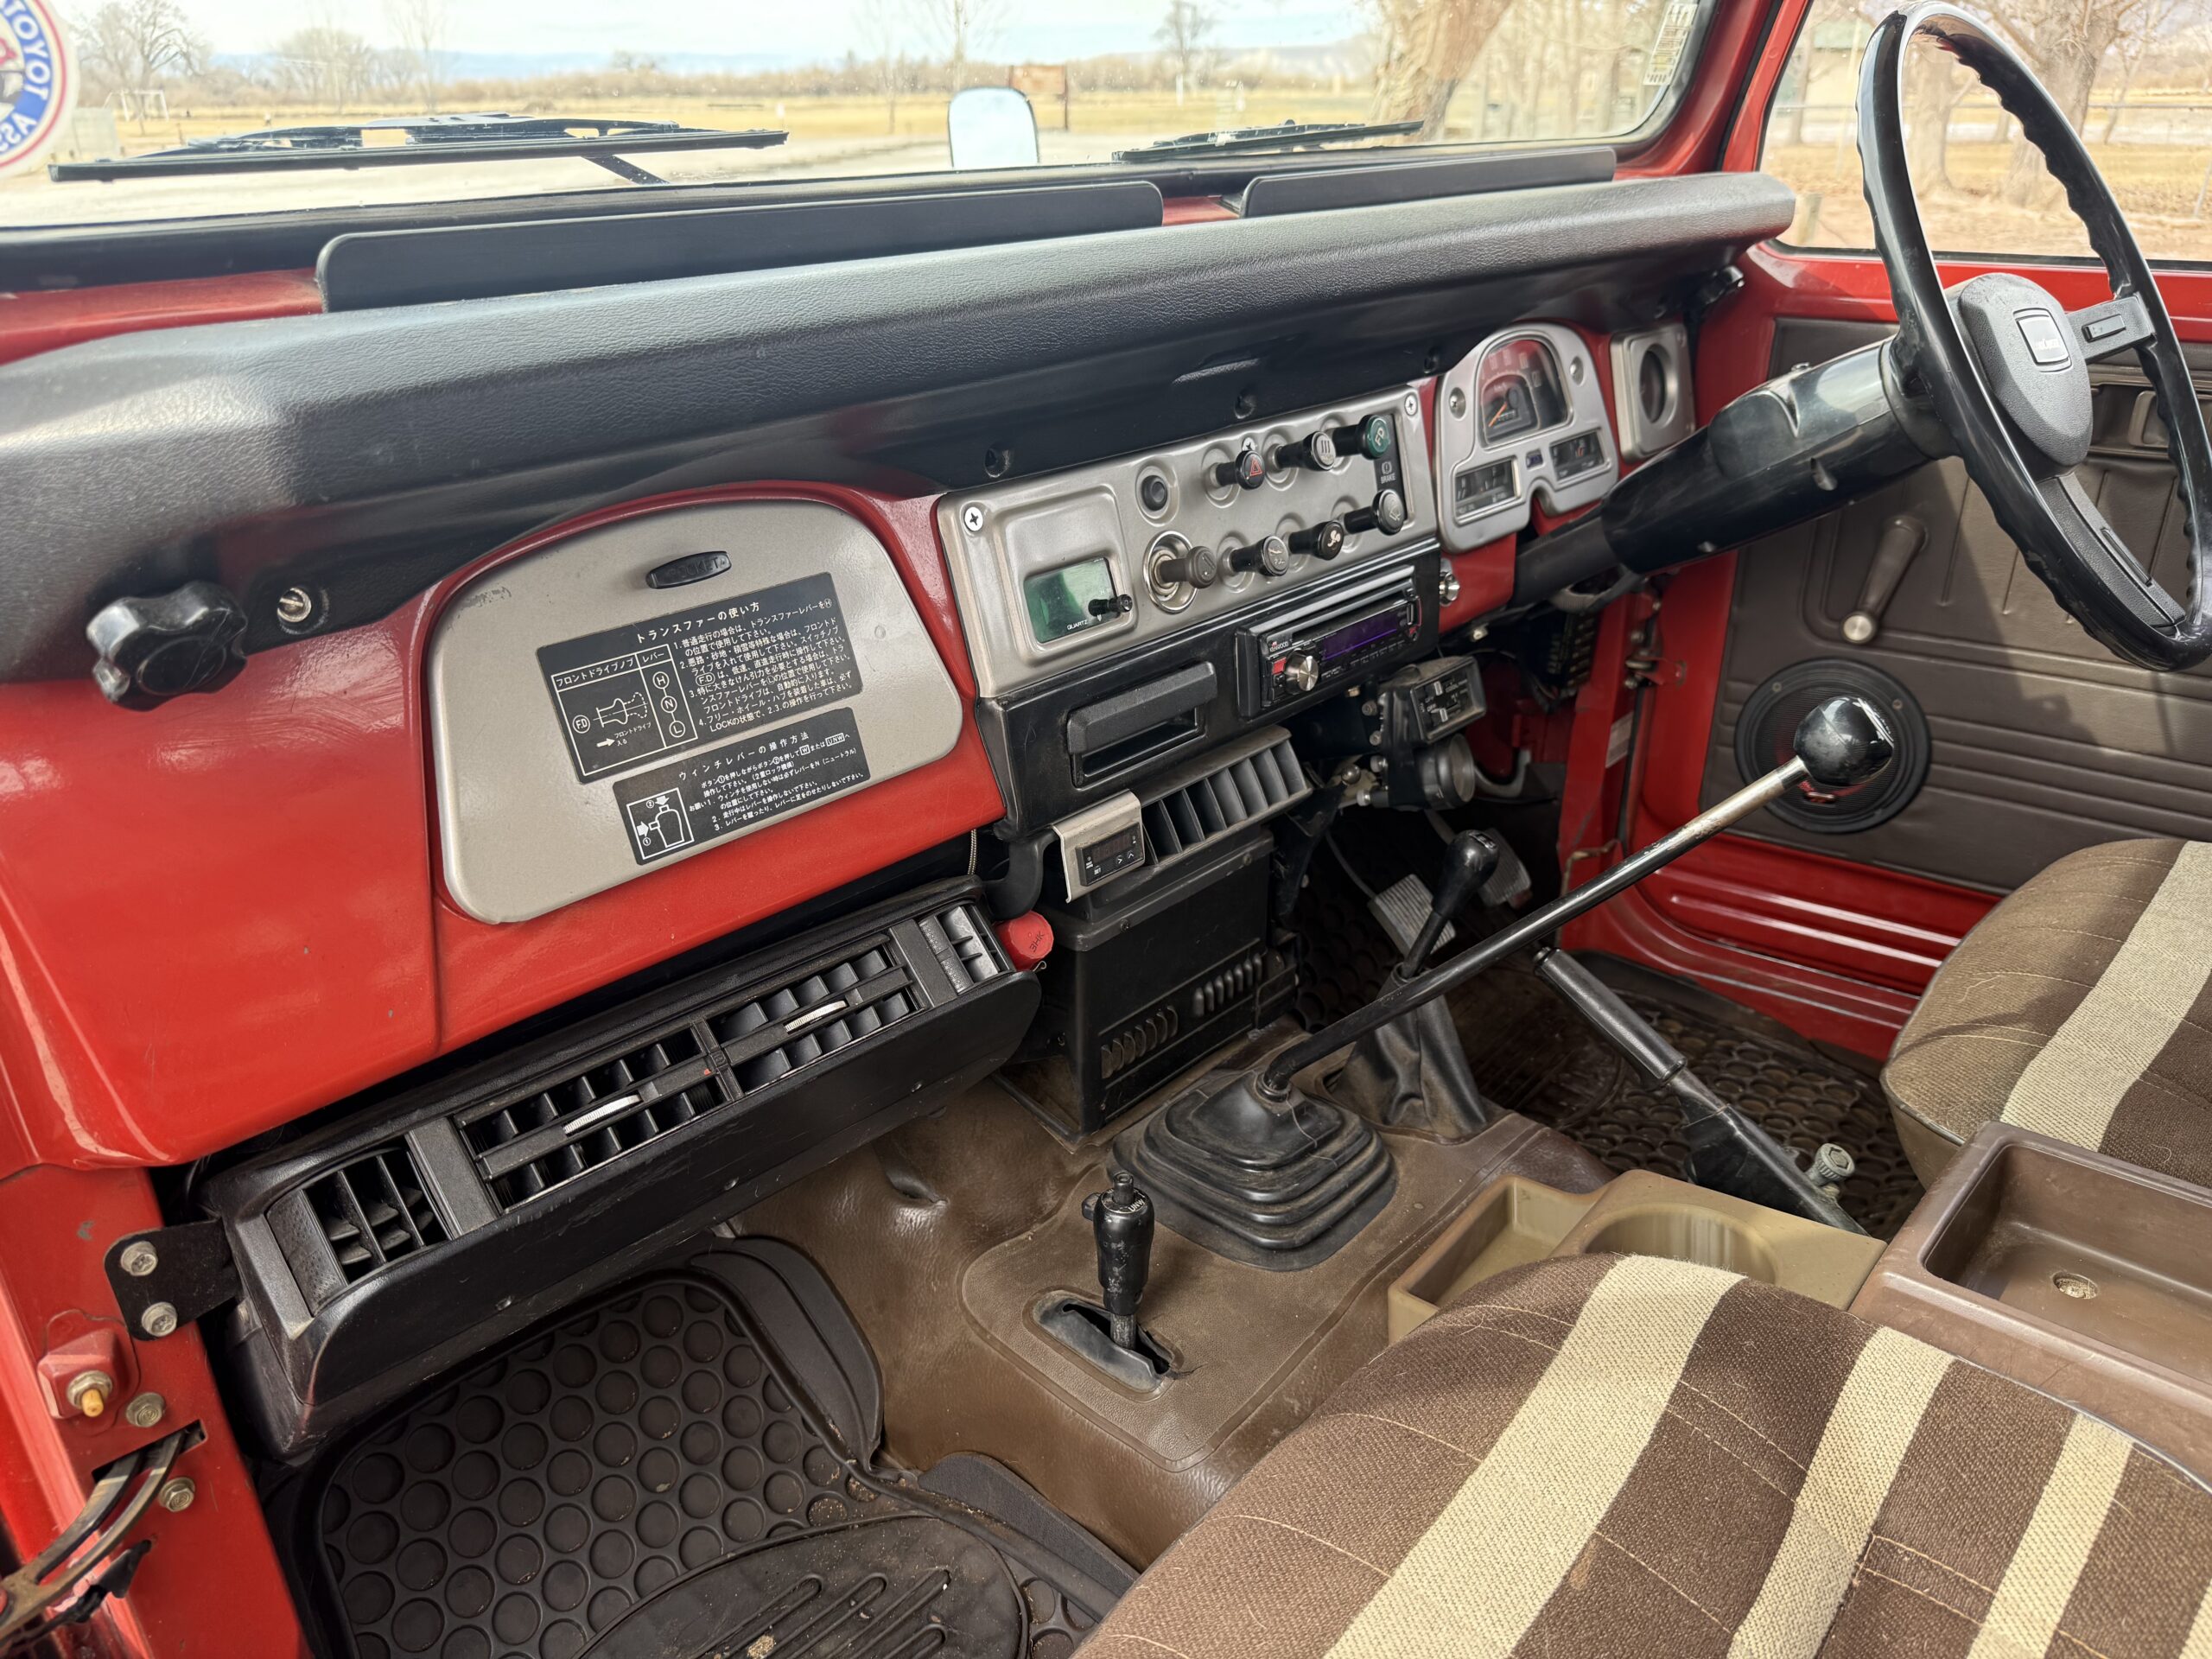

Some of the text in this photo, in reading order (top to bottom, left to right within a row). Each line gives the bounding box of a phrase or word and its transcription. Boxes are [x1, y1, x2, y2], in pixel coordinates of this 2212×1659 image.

[1380, 474, 1396, 485] BRAKE
[637, 601, 760, 644] トランスファーの使い方
[1066, 620, 1088, 630] QUARTZ
[685, 628, 772, 657] の位置で使用して下さい。
[1270, 641, 1289, 652] KENWOOD
[642, 652, 664, 663] レバー
[556, 658, 634, 687] フロントドライブノブ
[703, 668, 835, 715] フロントドライブは、自動的に入ります。
[1128, 1198, 1145, 1212] UNW
